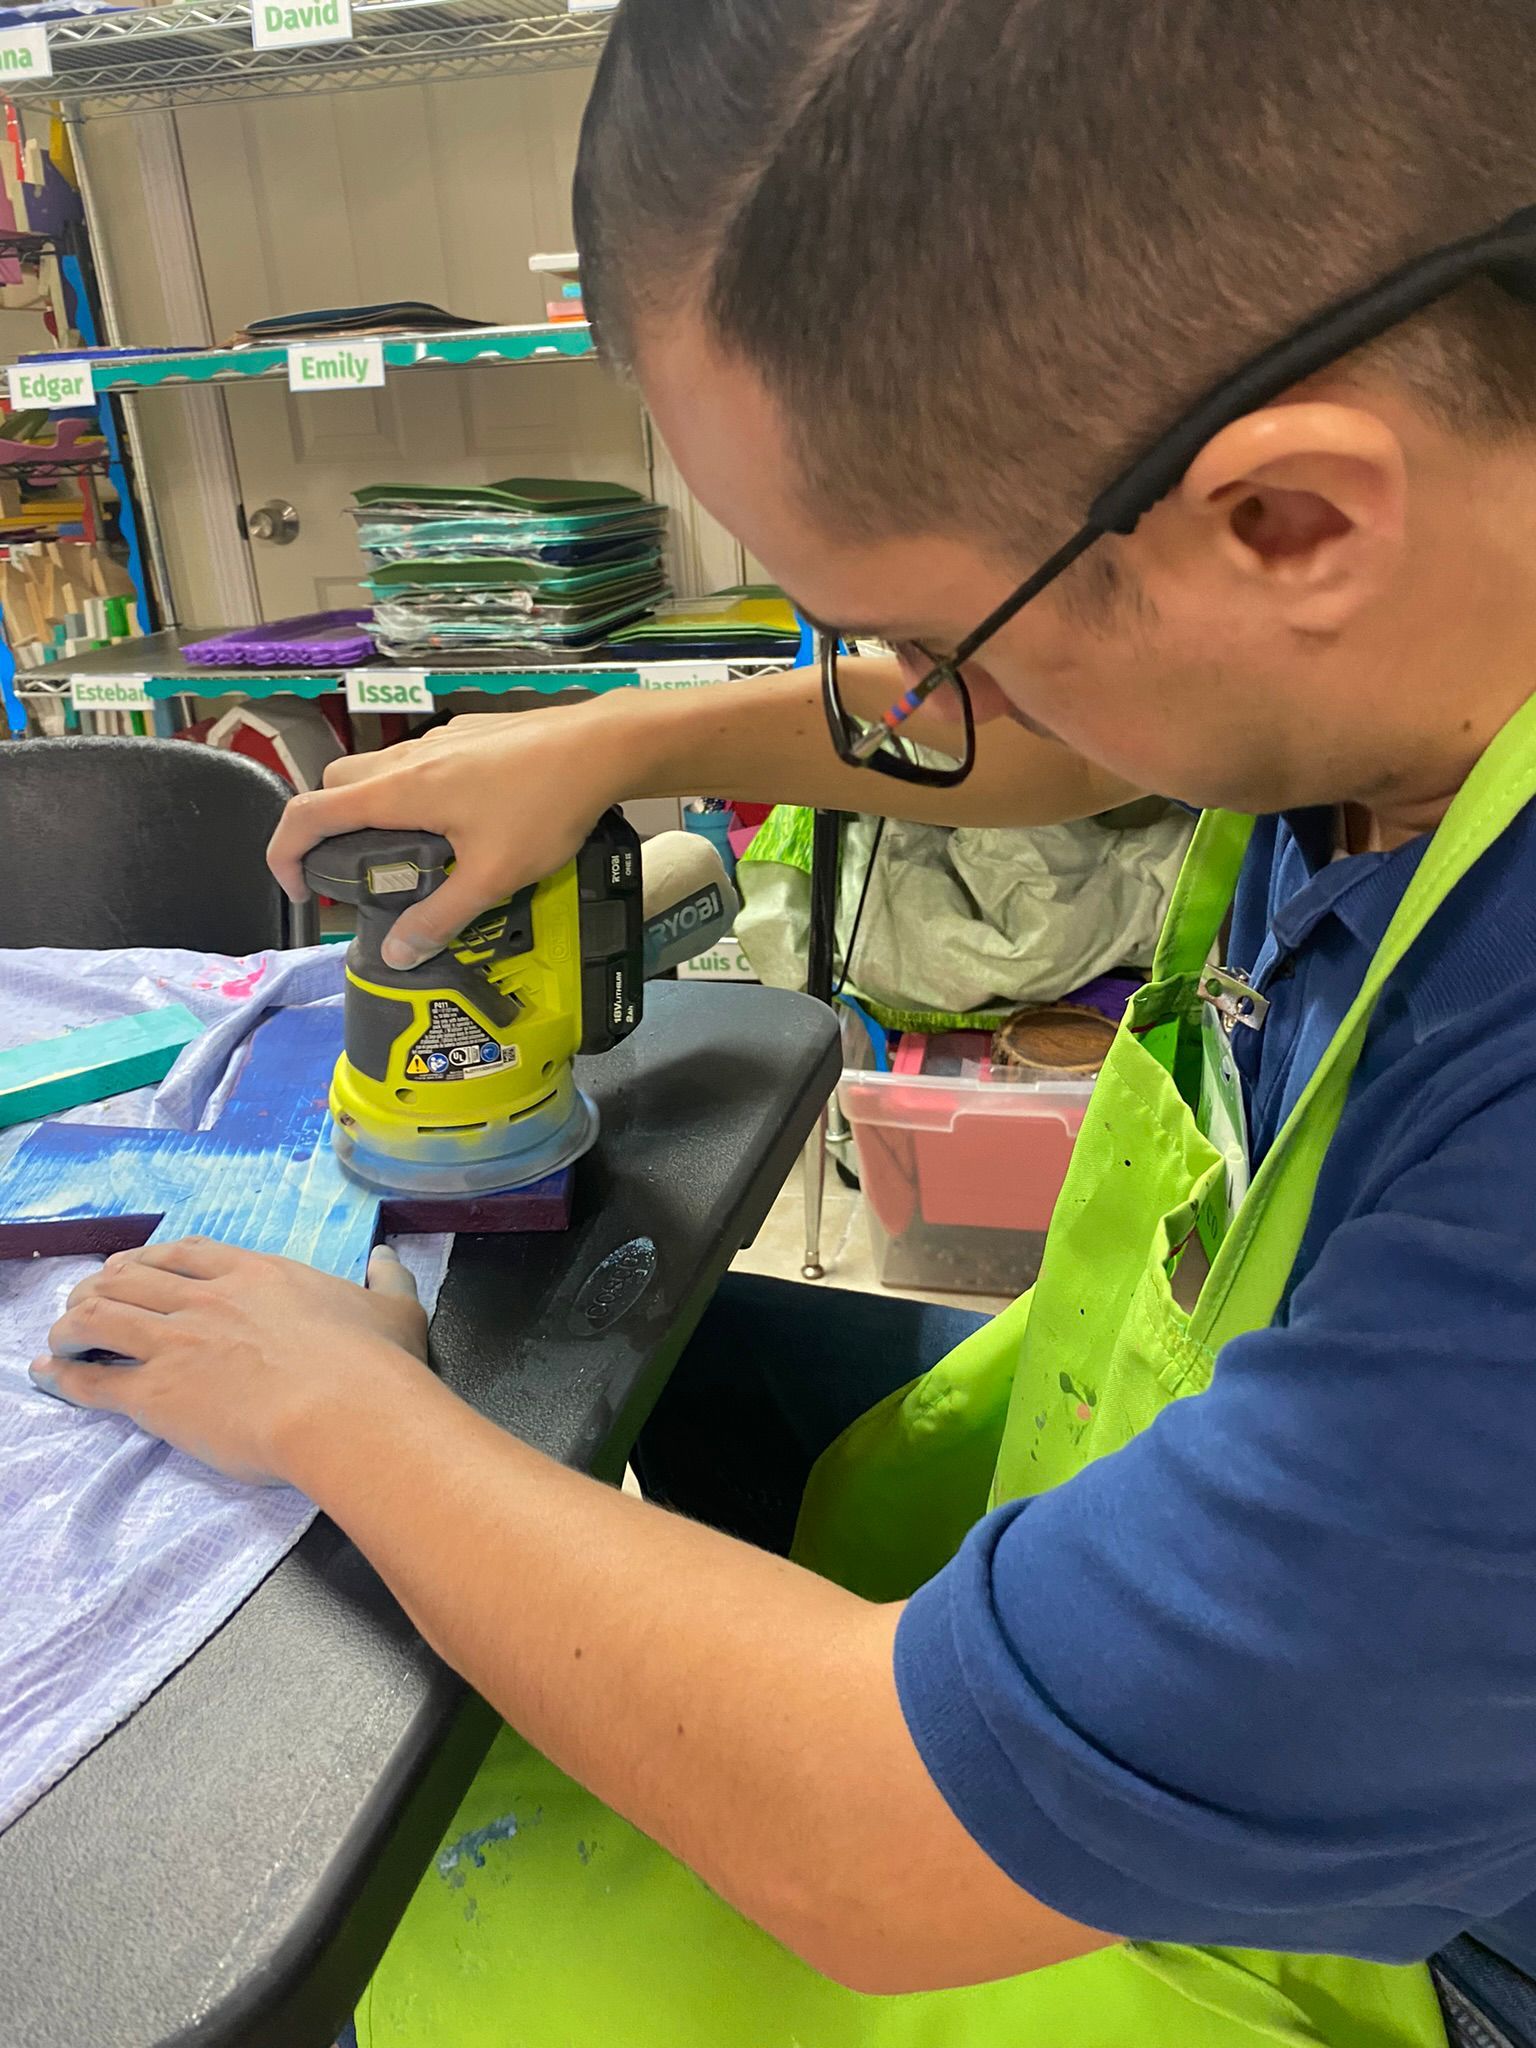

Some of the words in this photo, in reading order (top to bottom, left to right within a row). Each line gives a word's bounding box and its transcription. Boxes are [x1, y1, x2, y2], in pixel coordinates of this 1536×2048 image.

[264, 0, 339, 32] David
[0, 47, 33, 70] na
[301, 351, 369, 384] Emily
[19, 373, 83, 403] Edgar
[358, 680, 423, 704] Issac
[611, 854, 621, 884] RYOBI
[648, 891, 720, 945] RYOBI
[687, 952, 731, 972] Luis
